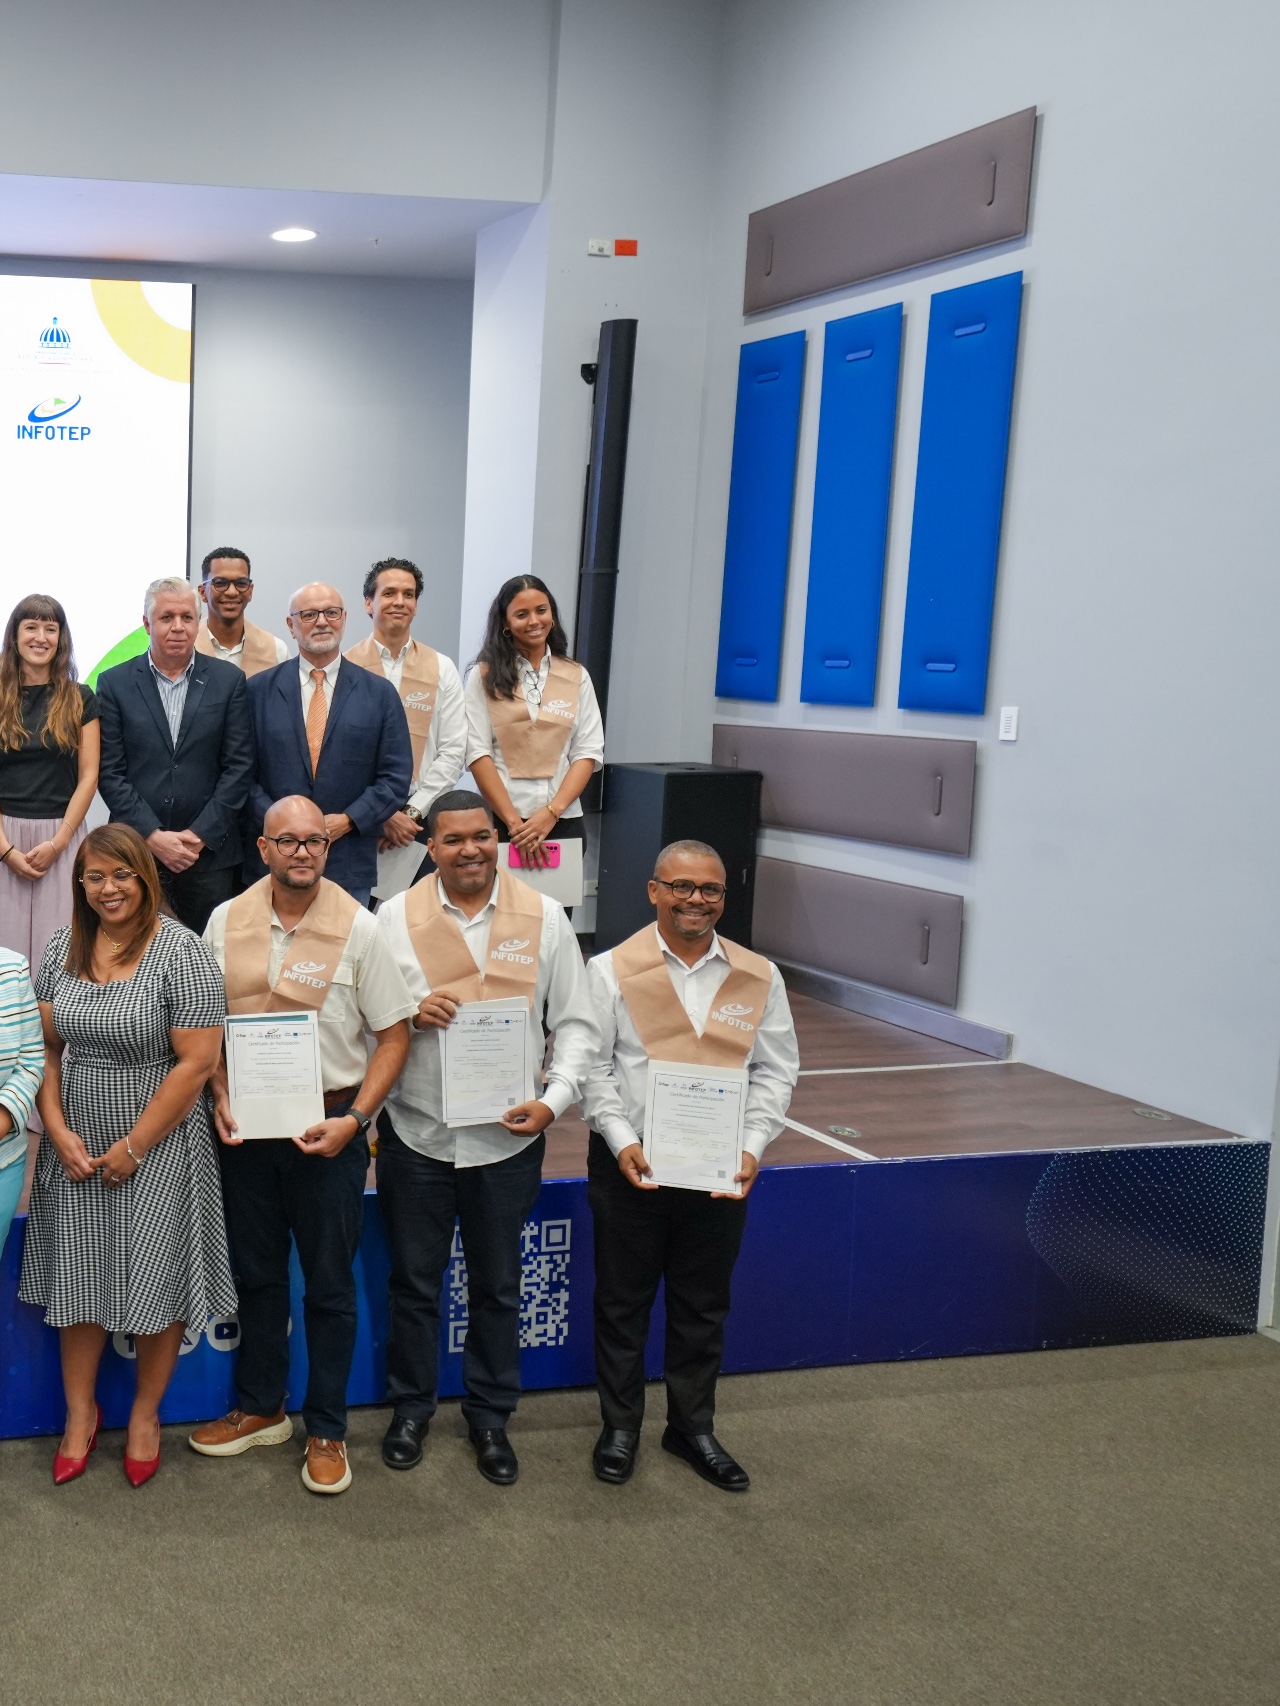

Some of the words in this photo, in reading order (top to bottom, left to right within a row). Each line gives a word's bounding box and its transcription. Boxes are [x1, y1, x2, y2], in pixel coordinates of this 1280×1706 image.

[17, 425, 91, 441] INFOTEP
[542, 705, 575, 719] INFOTEP
[491, 950, 534, 965] INFOTEP
[283, 969, 327, 989] INFOTEP
[712, 1010, 755, 1032] INFOTEP
